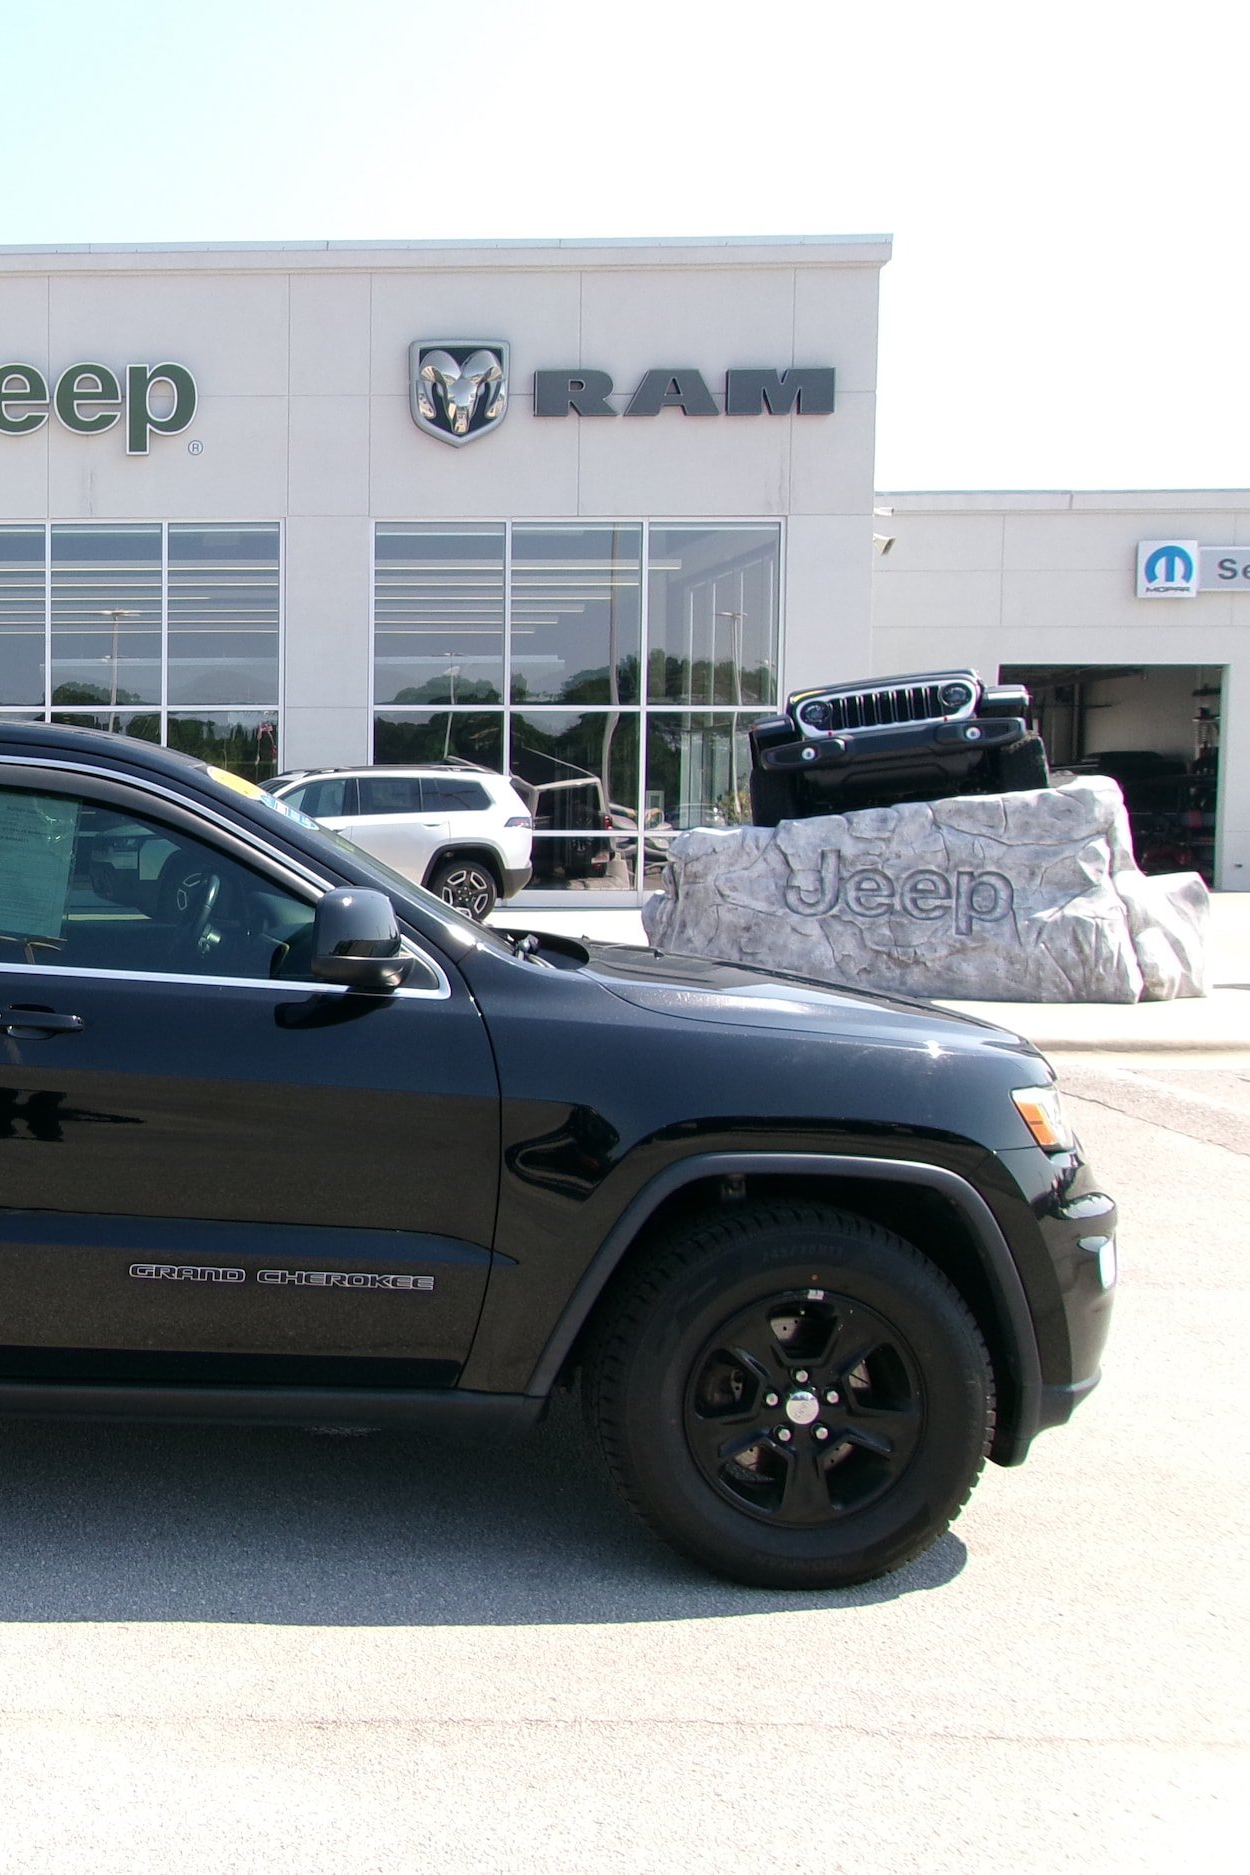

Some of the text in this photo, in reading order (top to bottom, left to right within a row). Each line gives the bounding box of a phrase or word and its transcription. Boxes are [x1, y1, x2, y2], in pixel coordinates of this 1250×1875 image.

[533, 367, 836, 417] RAM
[783, 849, 1014, 936] Jeep
[129, 1263, 435, 1291] GRAND CHEROKEE
